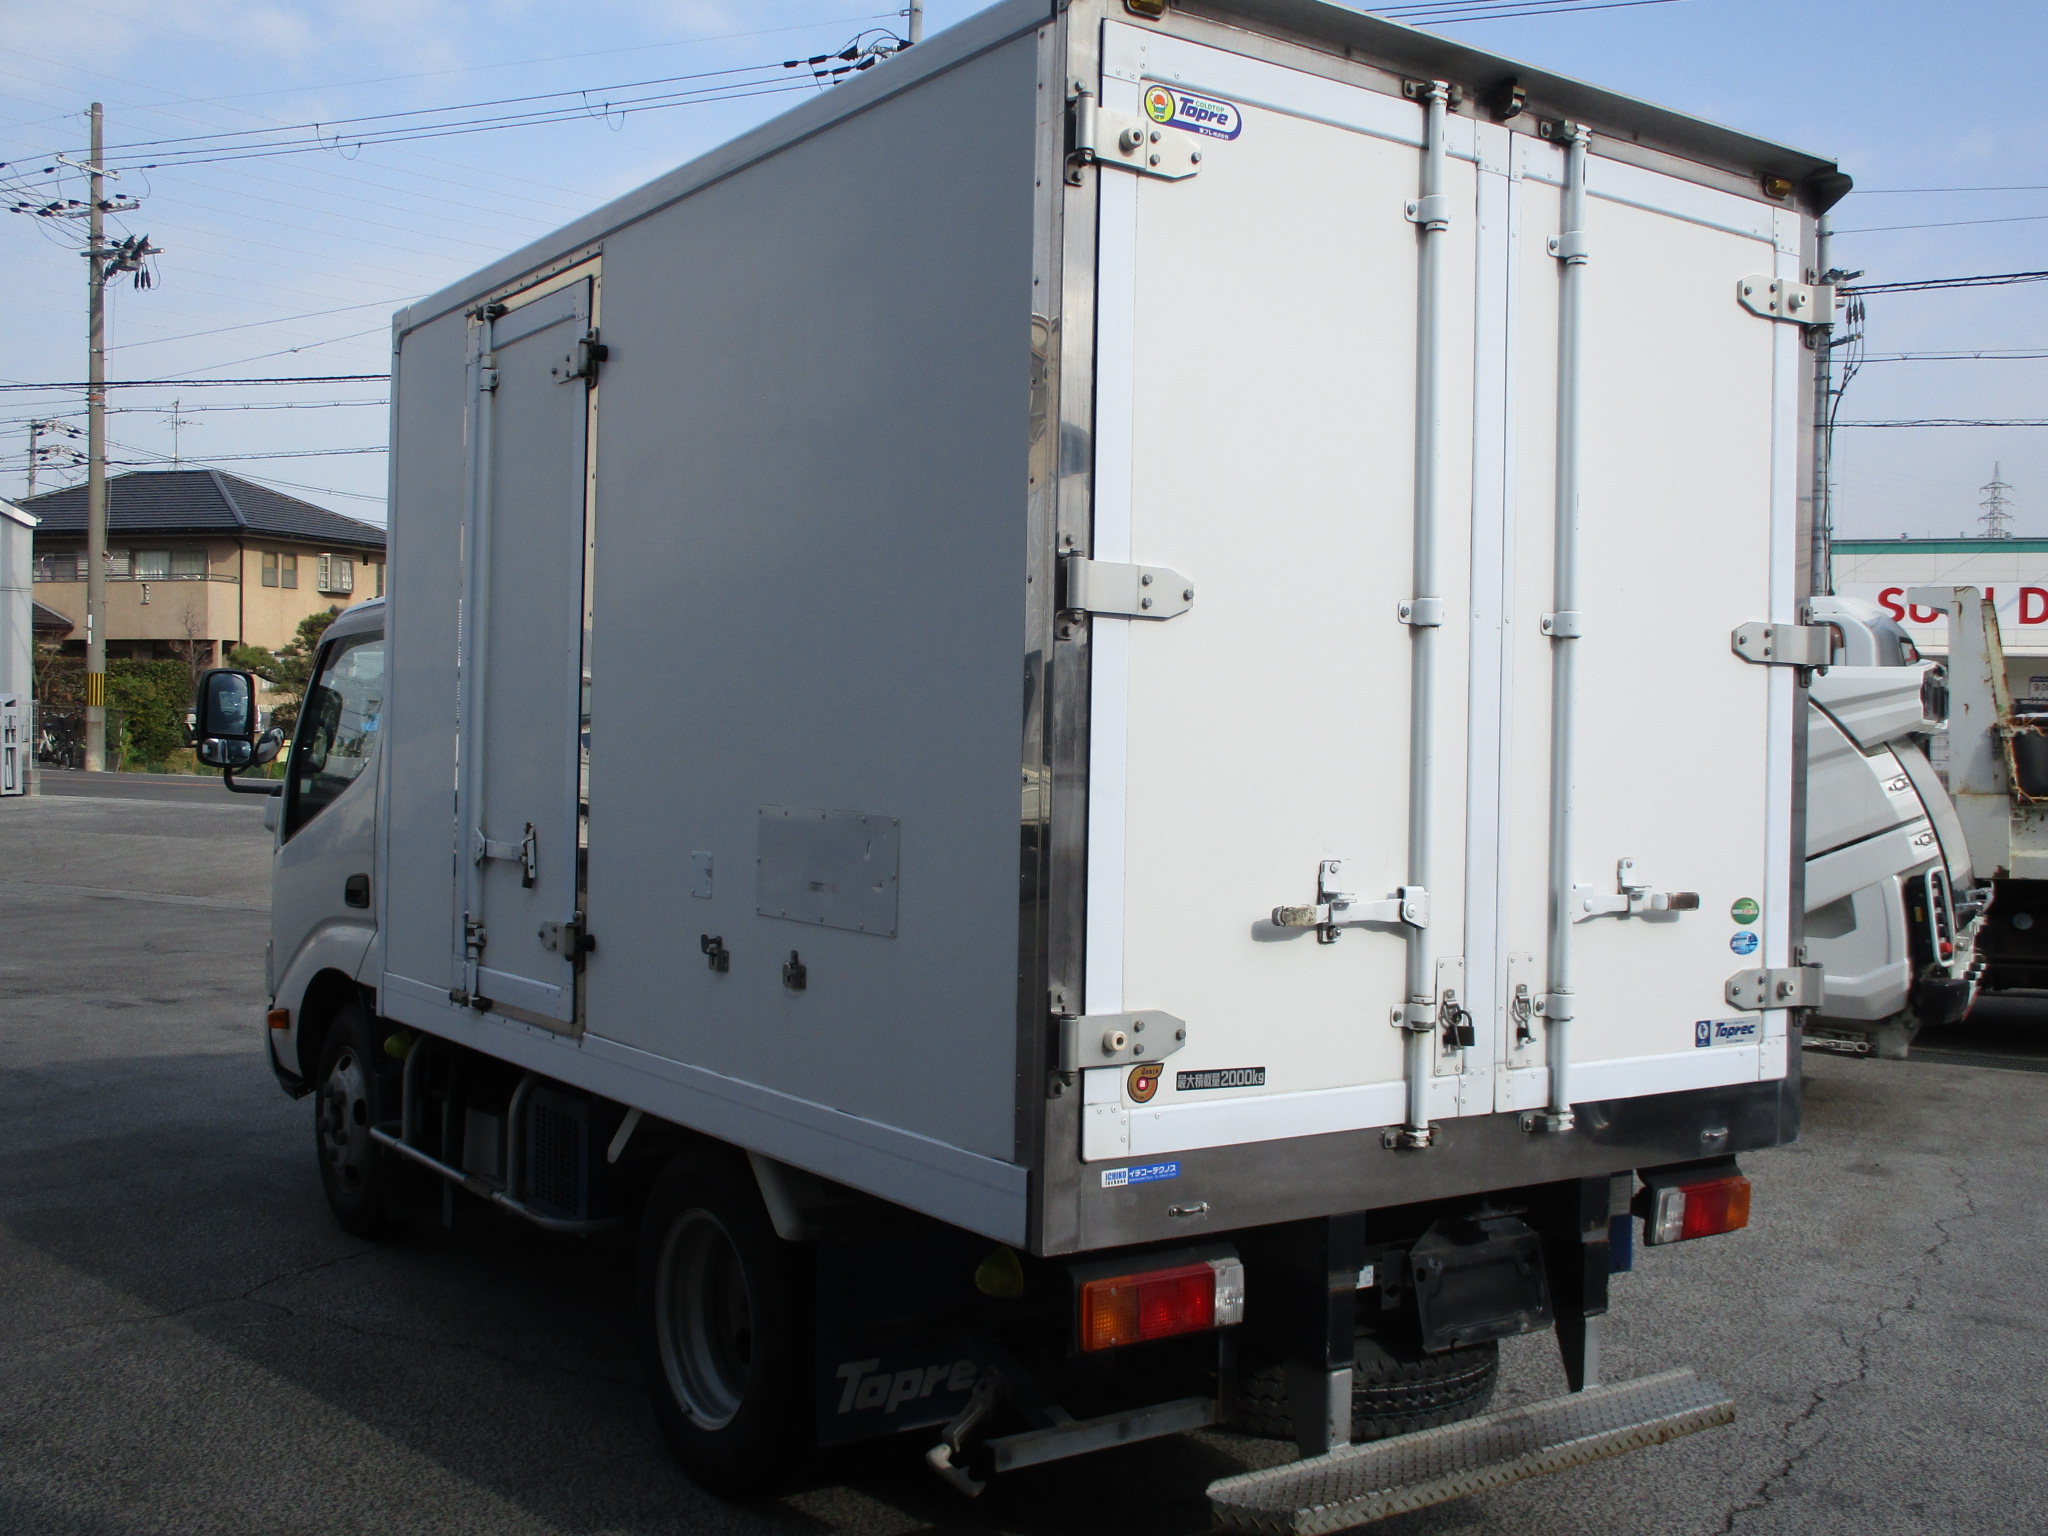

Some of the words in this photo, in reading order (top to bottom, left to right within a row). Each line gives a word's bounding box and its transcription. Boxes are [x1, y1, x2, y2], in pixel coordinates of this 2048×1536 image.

[1179, 96, 1229, 126] Topre
[1195, 100, 1225, 112] COLDTOP
[1714, 1022, 1756, 1039] Toprec
[1105, 1170, 1127, 1181] ICHIKO
[1128, 1164, 1177, 1178] イチコーテクノス
[835, 1357, 978, 1414] Topre
